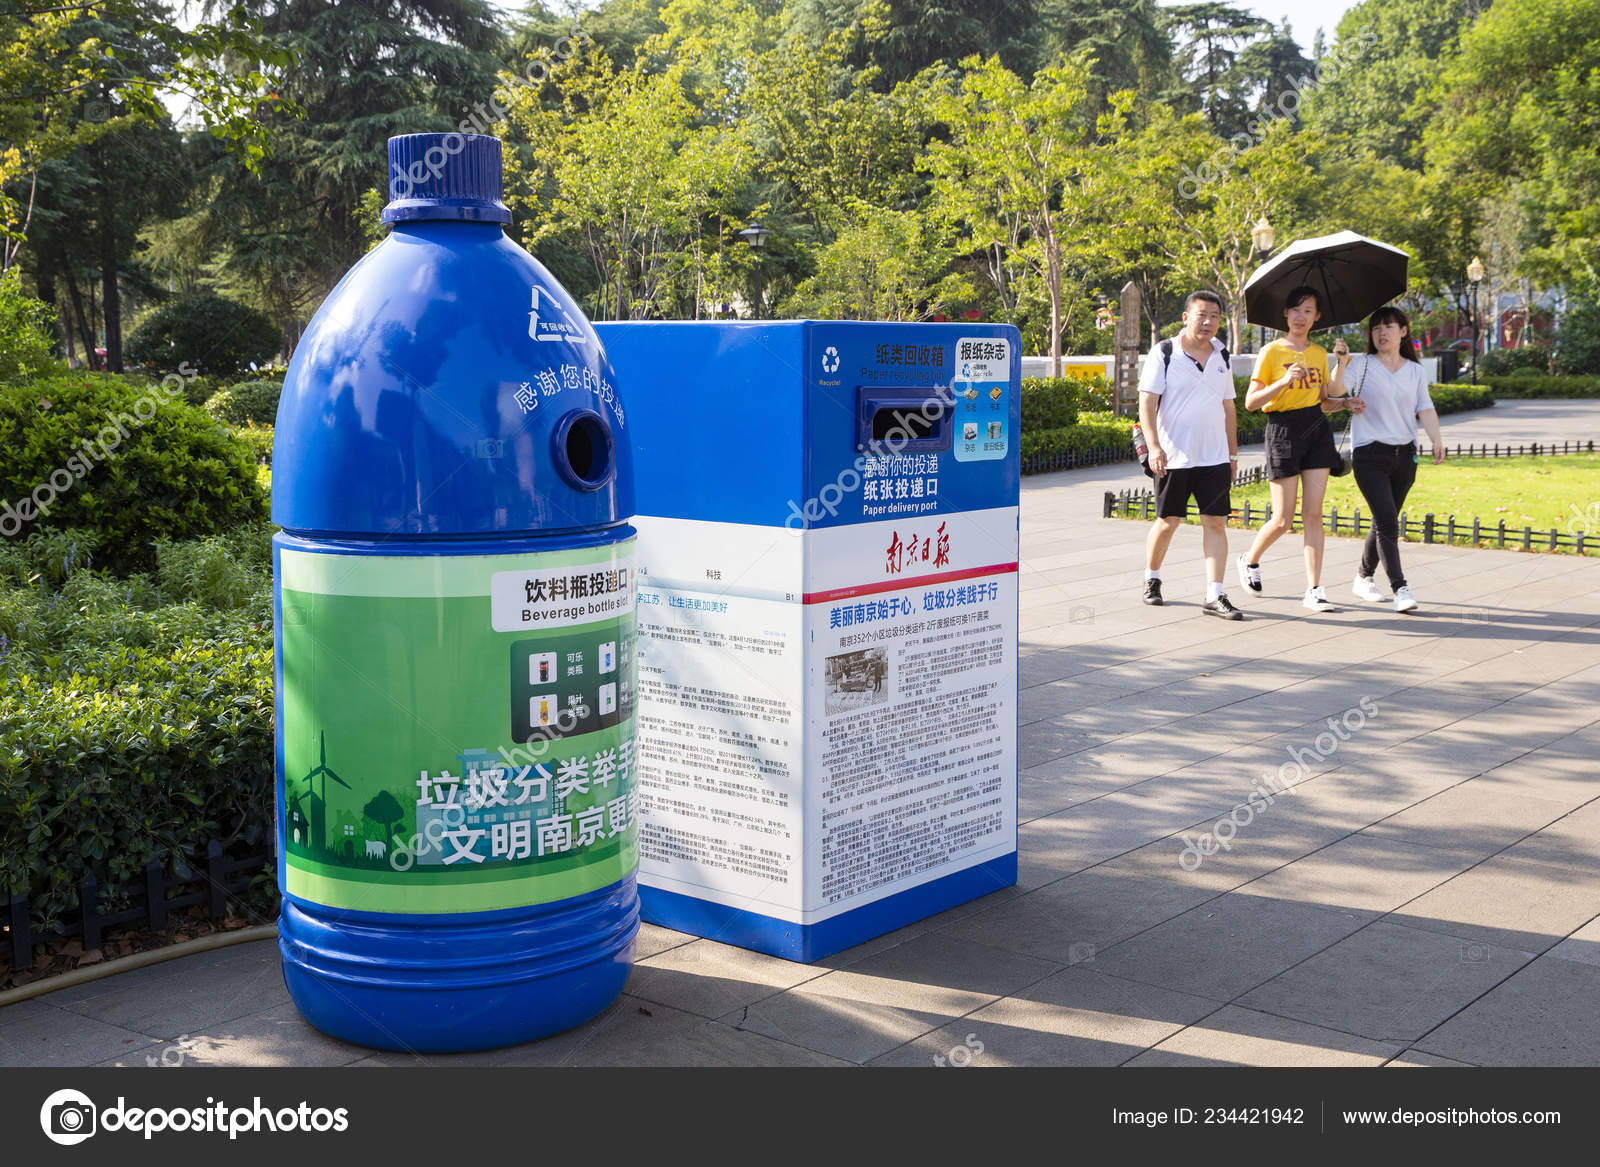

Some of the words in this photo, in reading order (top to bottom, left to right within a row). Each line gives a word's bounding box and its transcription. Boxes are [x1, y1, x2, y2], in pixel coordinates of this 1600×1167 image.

[876, 344, 944, 367] 纸类回收箱
[961, 342, 1005, 361] 报纸杂志
[513, 364, 624, 429] 感谢您的投递
[864, 454, 938, 478] 感谢你的投递
[864, 477, 938, 501] 纸张投递口
[864, 504, 886, 516] Paper
[888, 501, 919, 514] delivery
[920, 500, 937, 513] port
[525, 568, 627, 603] 饮料瓶投递口
[706, 569, 721, 580] 科技
[522, 605, 585, 622] Beverage
[588, 598, 615, 614] bottle
[616, 596, 628, 609] slot
[416, 739, 638, 810] 垃圾分类举手
